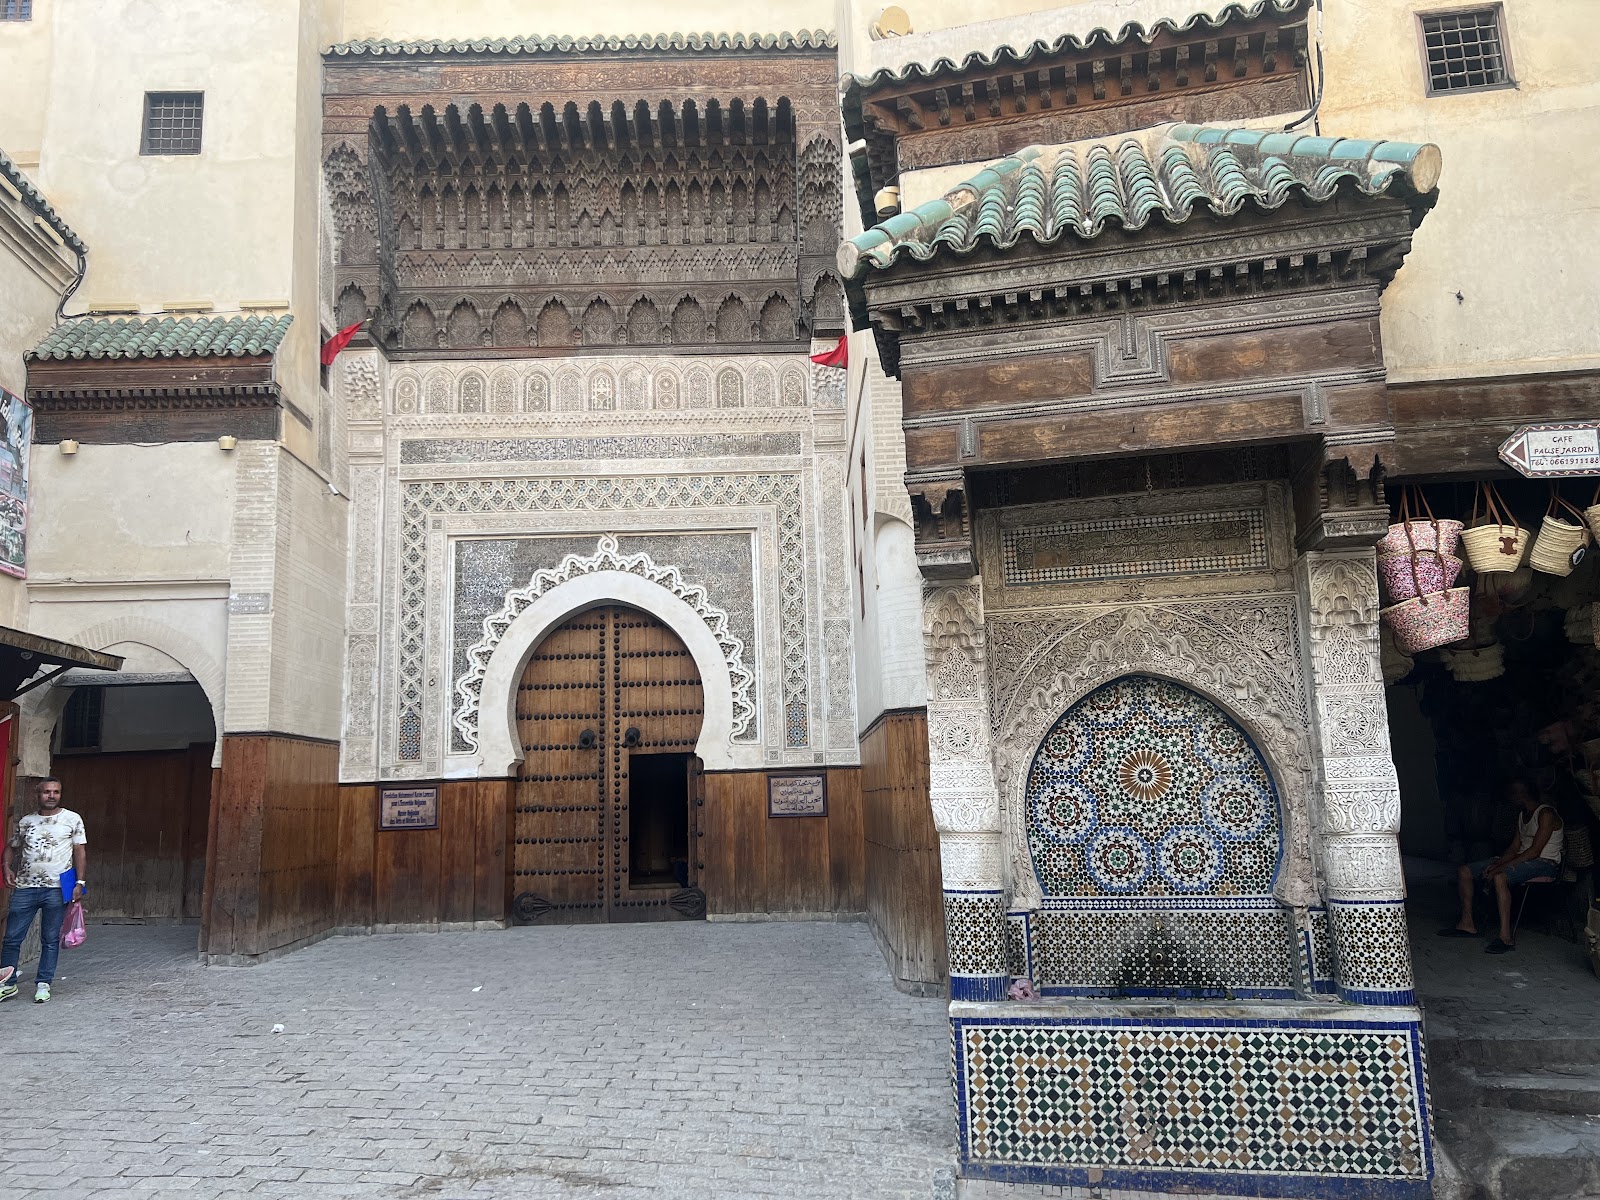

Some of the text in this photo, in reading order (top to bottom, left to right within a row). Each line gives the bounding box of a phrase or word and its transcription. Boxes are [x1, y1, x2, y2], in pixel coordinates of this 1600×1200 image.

[1552, 435, 1573, 443] CAFE
[1534, 446, 1594, 455] PAUSE JARDIN
